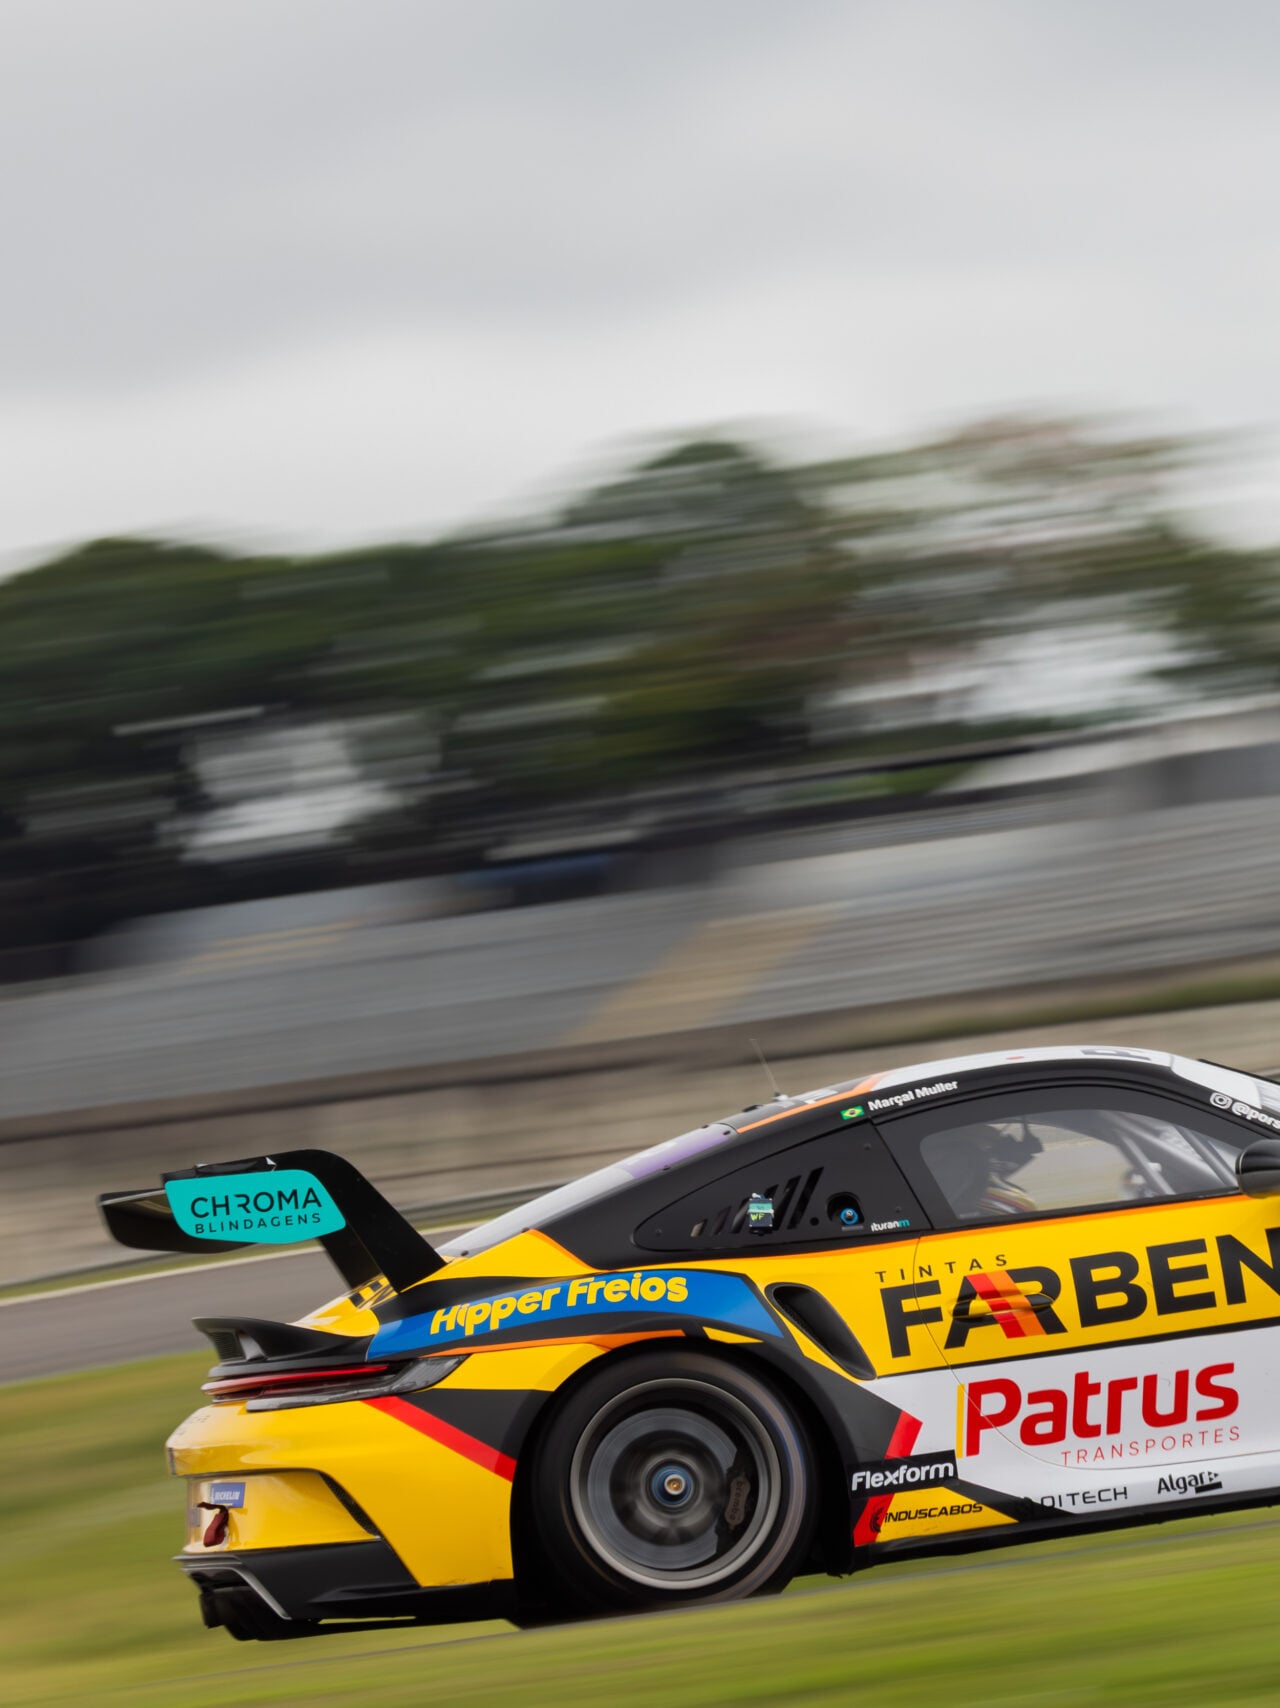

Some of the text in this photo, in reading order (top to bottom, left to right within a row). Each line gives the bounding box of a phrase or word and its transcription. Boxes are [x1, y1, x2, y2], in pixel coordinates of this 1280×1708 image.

[868, 1080, 958, 1111] Marçal Muller
[190, 1187, 322, 1219] CHROMA
[195, 1212, 321, 1234] BLINDAGENS
[874, 1254, 1008, 1283] TINTAS
[429, 1272, 689, 1337] Hipper Freios
[965, 1362, 1240, 1458] Patrus
[1060, 1426, 1240, 1468] TRANSPORTES
[851, 1461, 954, 1491] Flexform
[1157, 1472, 1205, 1495] Algar
